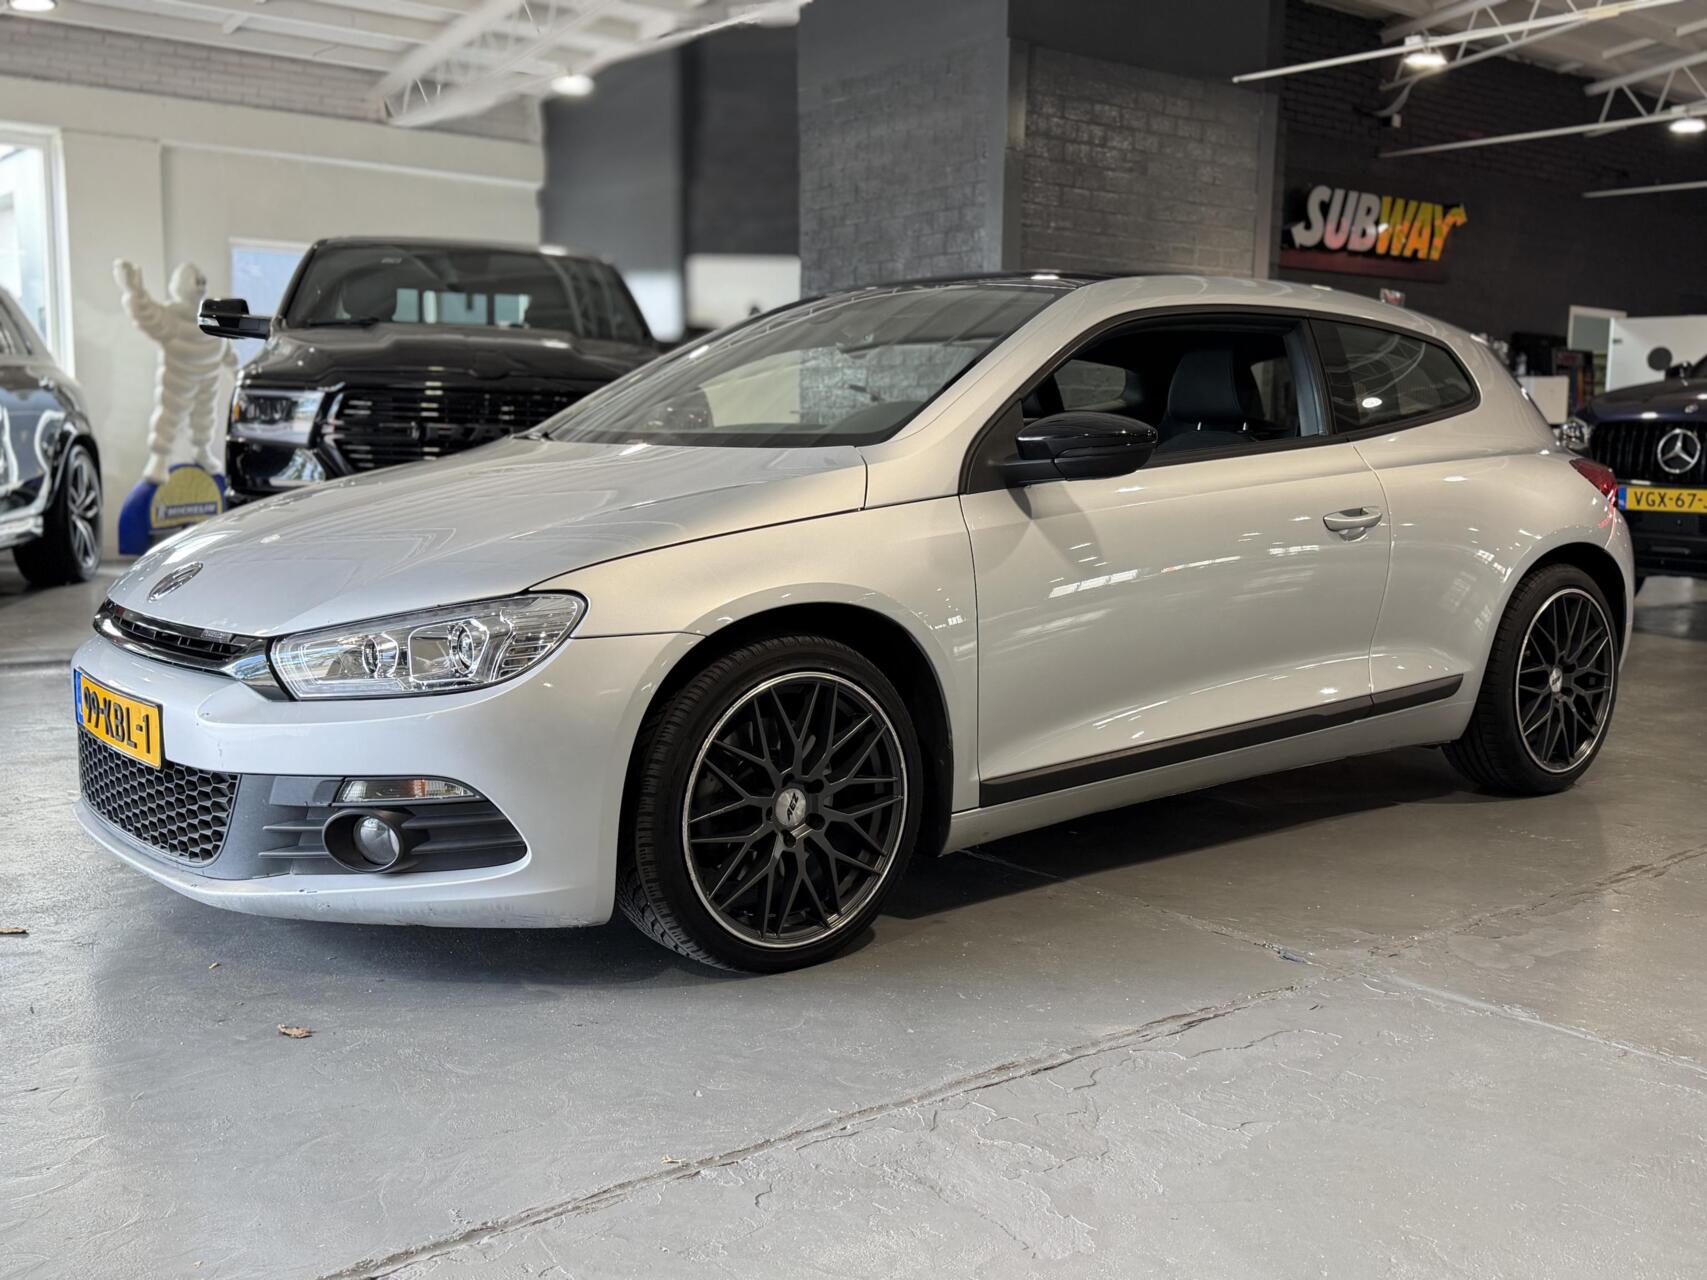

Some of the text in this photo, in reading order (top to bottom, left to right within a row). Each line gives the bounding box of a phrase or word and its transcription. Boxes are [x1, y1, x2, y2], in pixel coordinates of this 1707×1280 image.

[1291, 185, 1467, 262] SUBWAY
[1634, 491, 1707, 508] VGX-67-
[84, 686, 151, 754] 99-KBL-1
